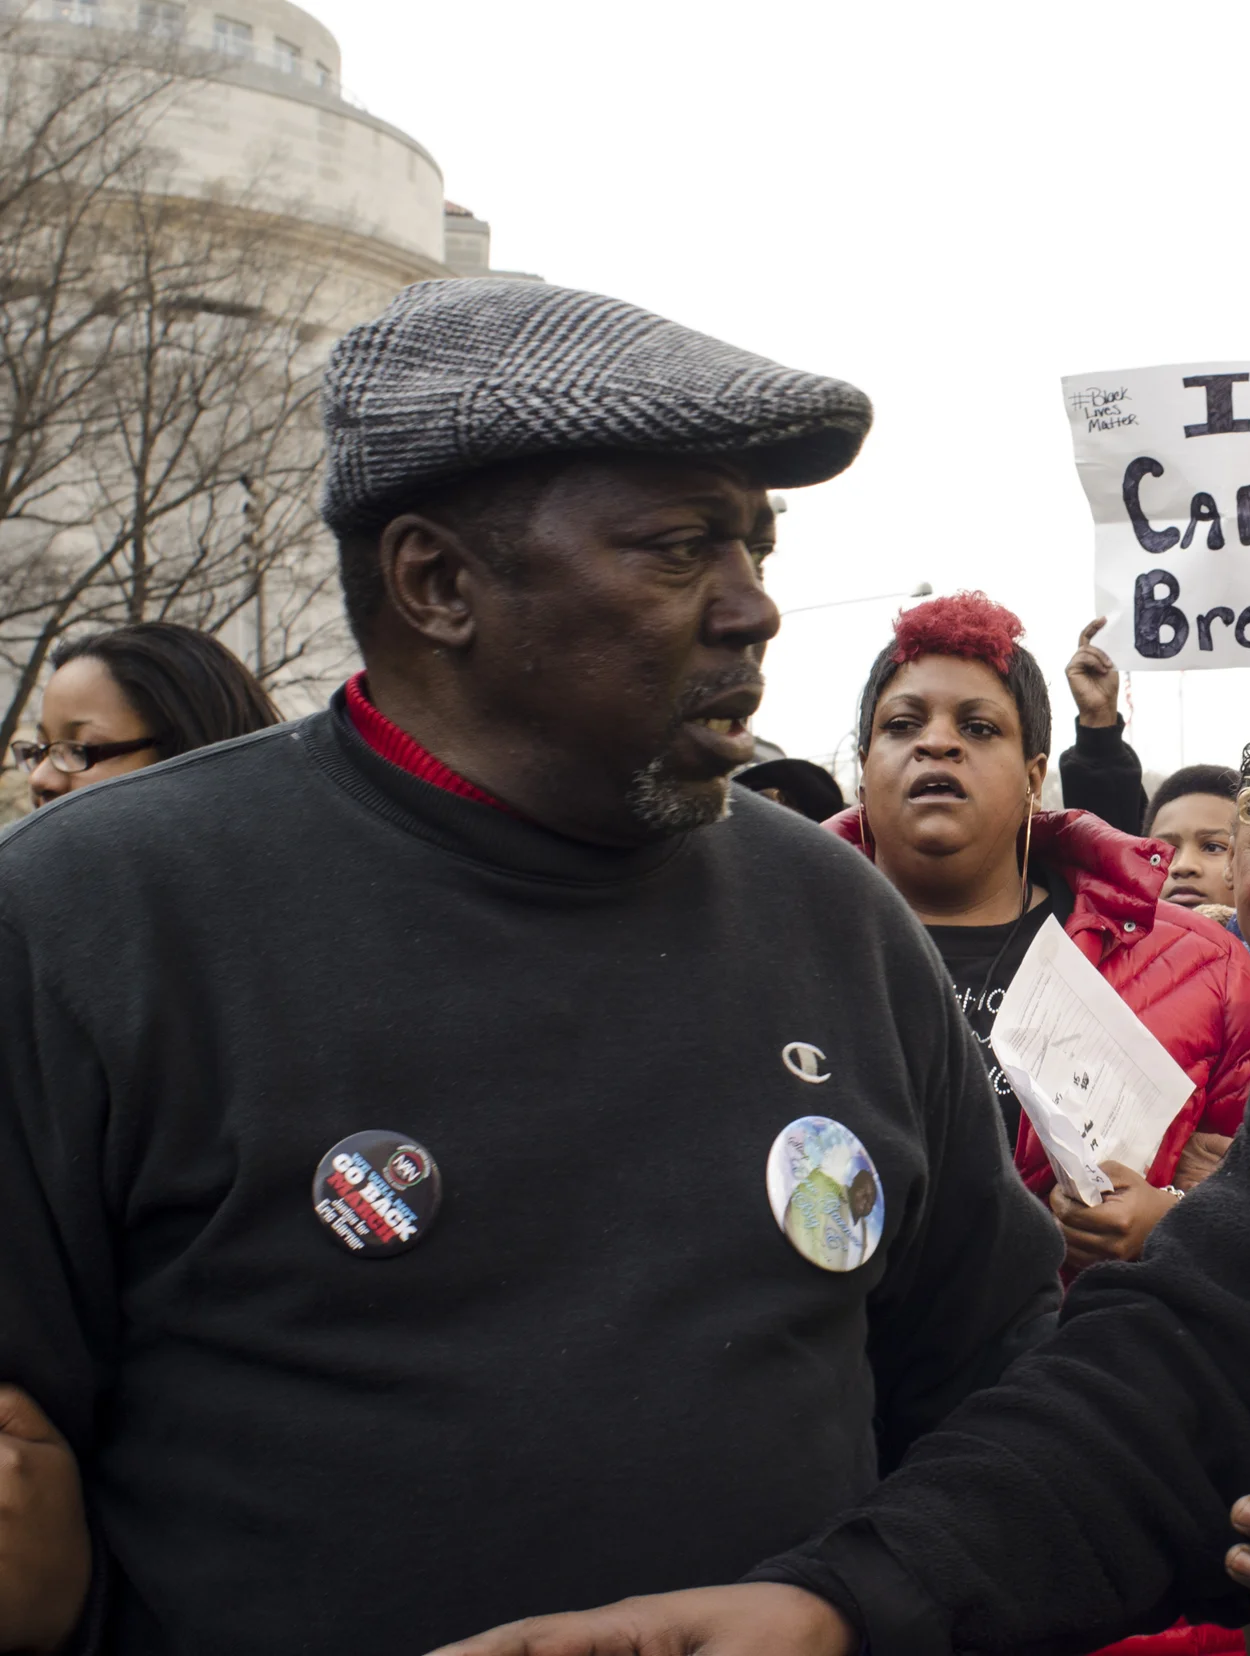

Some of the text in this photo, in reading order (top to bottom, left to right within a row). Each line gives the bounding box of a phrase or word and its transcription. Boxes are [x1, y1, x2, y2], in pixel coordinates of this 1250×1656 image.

[1068, 386, 1133, 411] #Black
[1085, 405, 1122, 420] Lives
[1182, 372, 1250, 439] I
[351, 1151, 372, 1173] WE
[367, 1170, 397, 1201] WILL
[392, 1197, 418, 1222] NOT
[392, 1153, 421, 1182] NAN
[315, 1198, 339, 1223] Eric
[326, 1170, 397, 1244] MARCH
[331, 1197, 371, 1236] Justice for
[332, 1152, 365, 1185] GO
[358, 1182, 418, 1243] BACK
